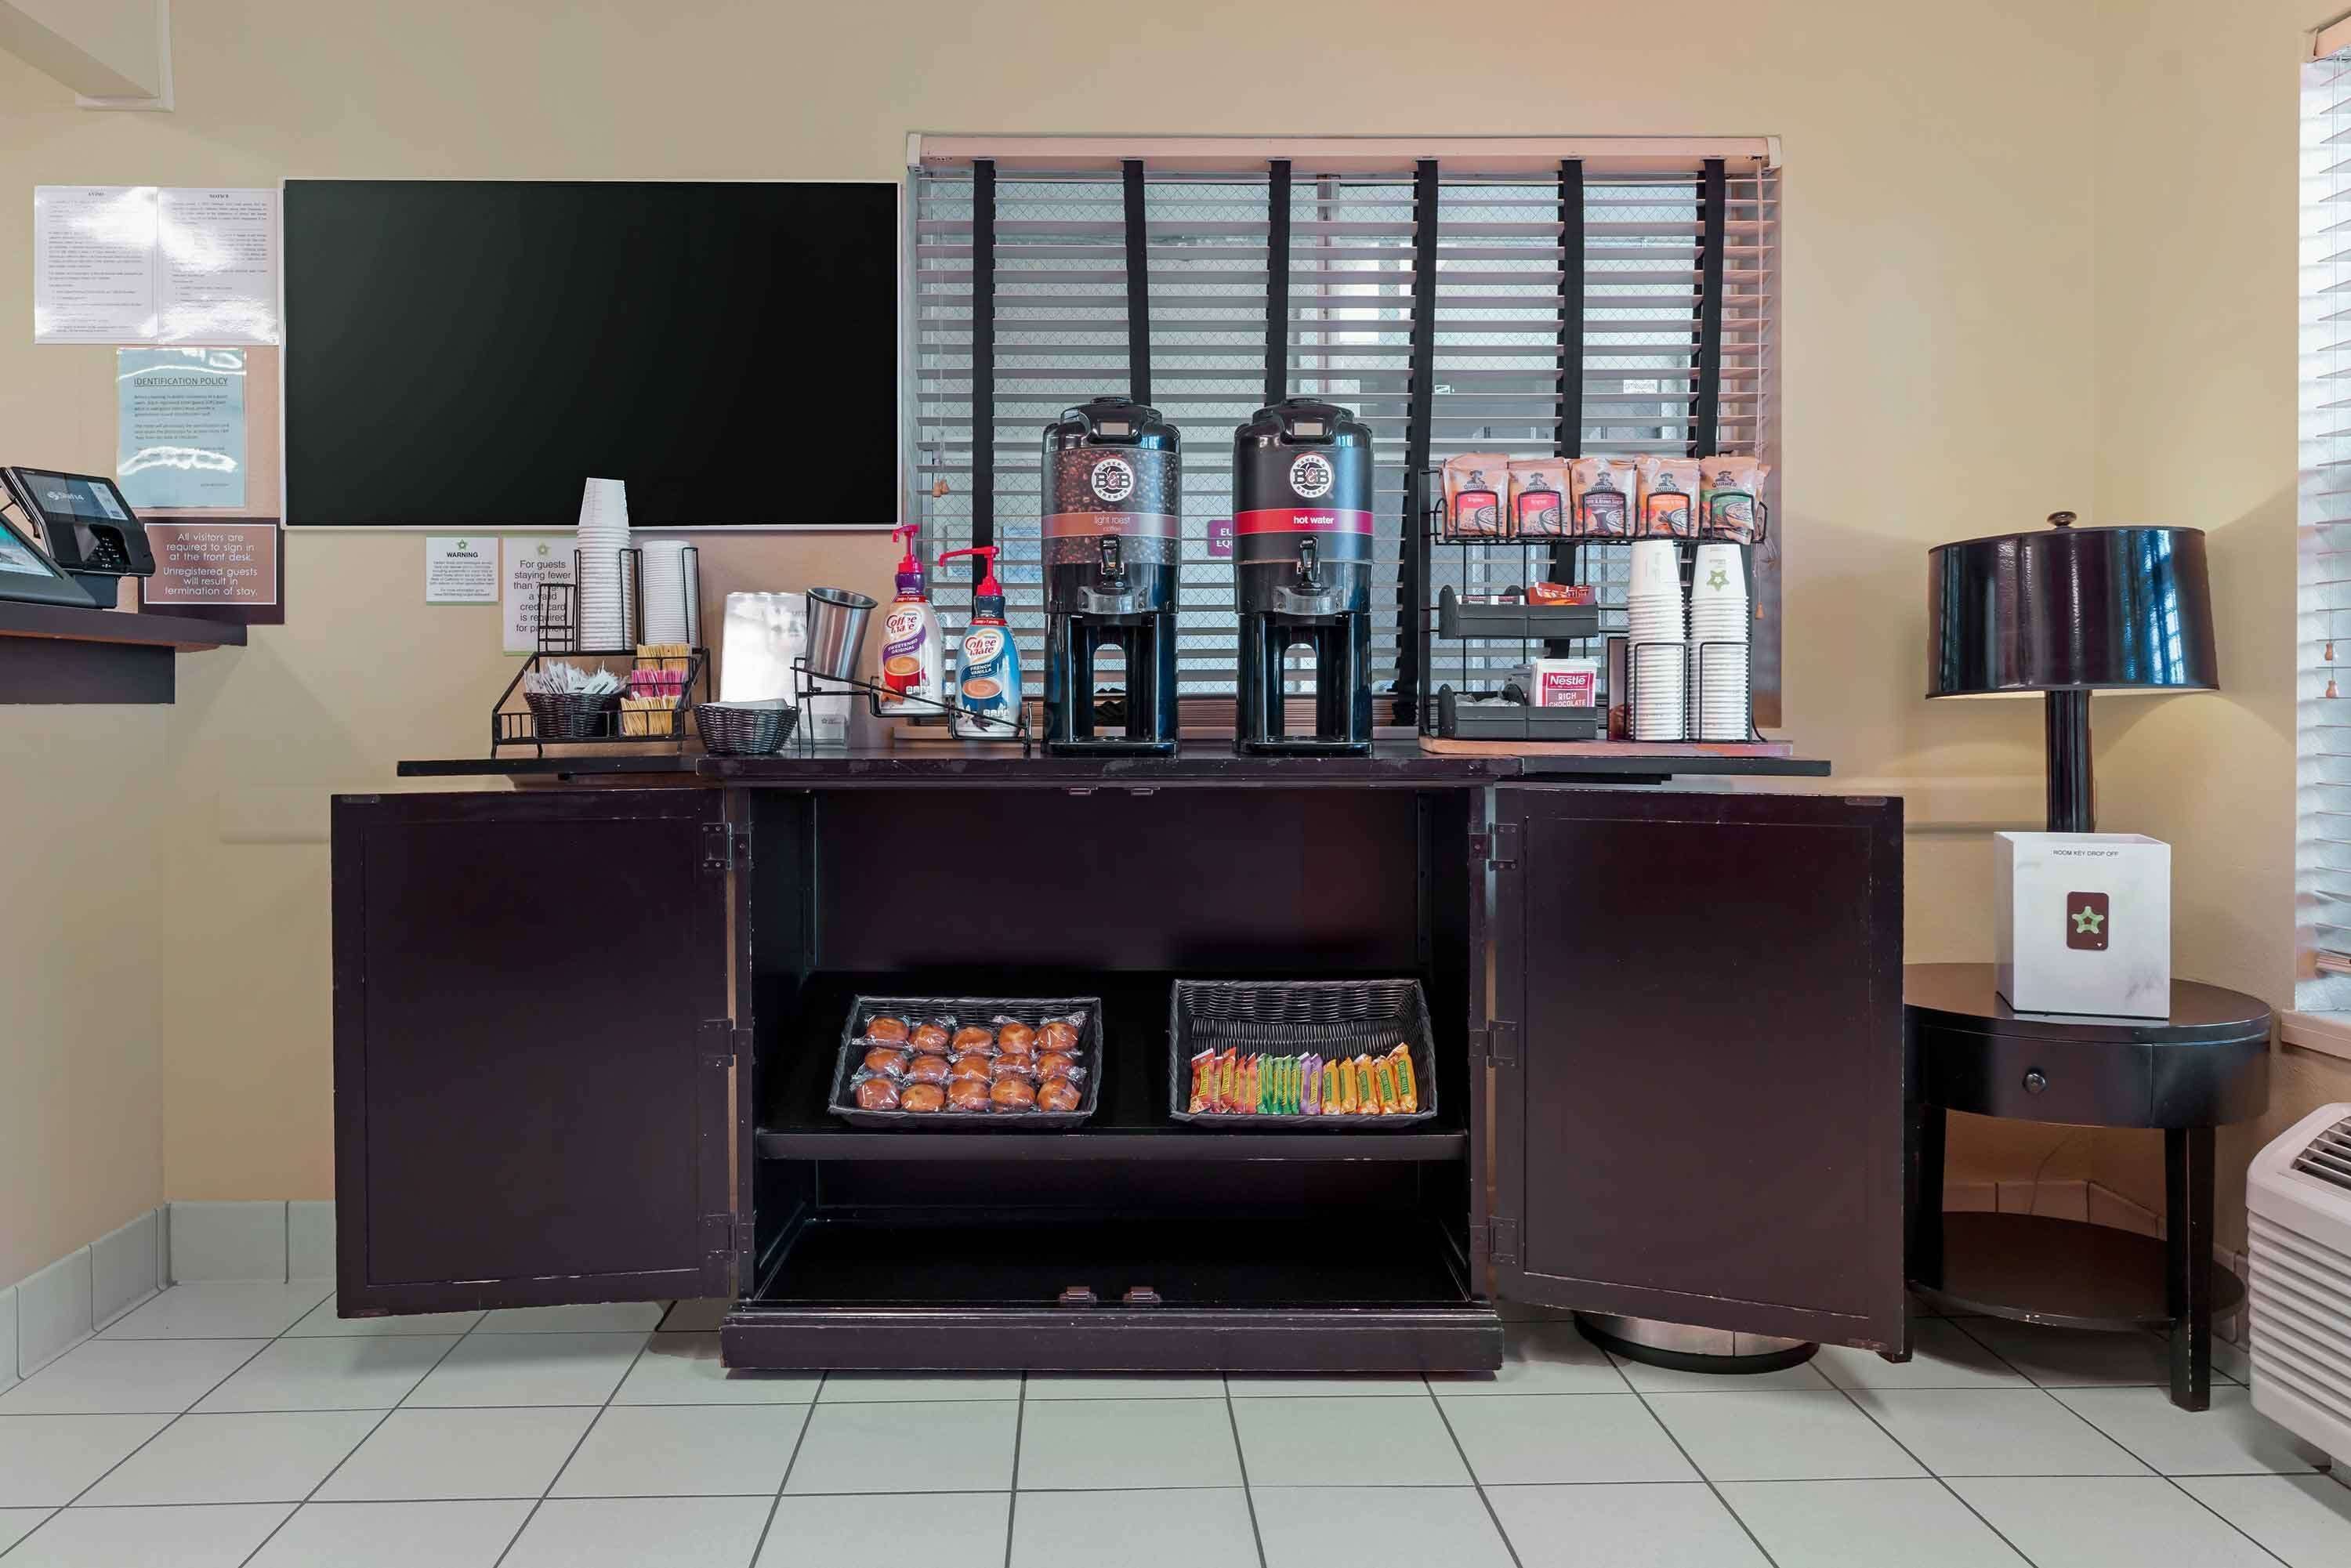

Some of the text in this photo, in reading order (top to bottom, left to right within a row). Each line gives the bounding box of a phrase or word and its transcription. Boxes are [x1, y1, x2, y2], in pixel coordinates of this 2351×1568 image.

[134, 377, 198, 386] IDENTIFICATION
[1095, 470, 1131, 489] B&B
[1293, 468, 1329, 485] B&B
[1094, 515, 1130, 526] light roast
[1293, 516, 1309, 524] hot
[193, 532, 224, 541] visitors
[166, 543, 208, 553] required
[224, 544, 242, 554] sign
[537, 561, 566, 570] guests
[163, 567, 258, 578] Unregistered guests
[514, 571, 545, 581] staying
[888, 638, 918, 651] SWEETENED
[1558, 692, 1577, 701] RICH
[1549, 699, 1586, 708] CHOCOLATE
